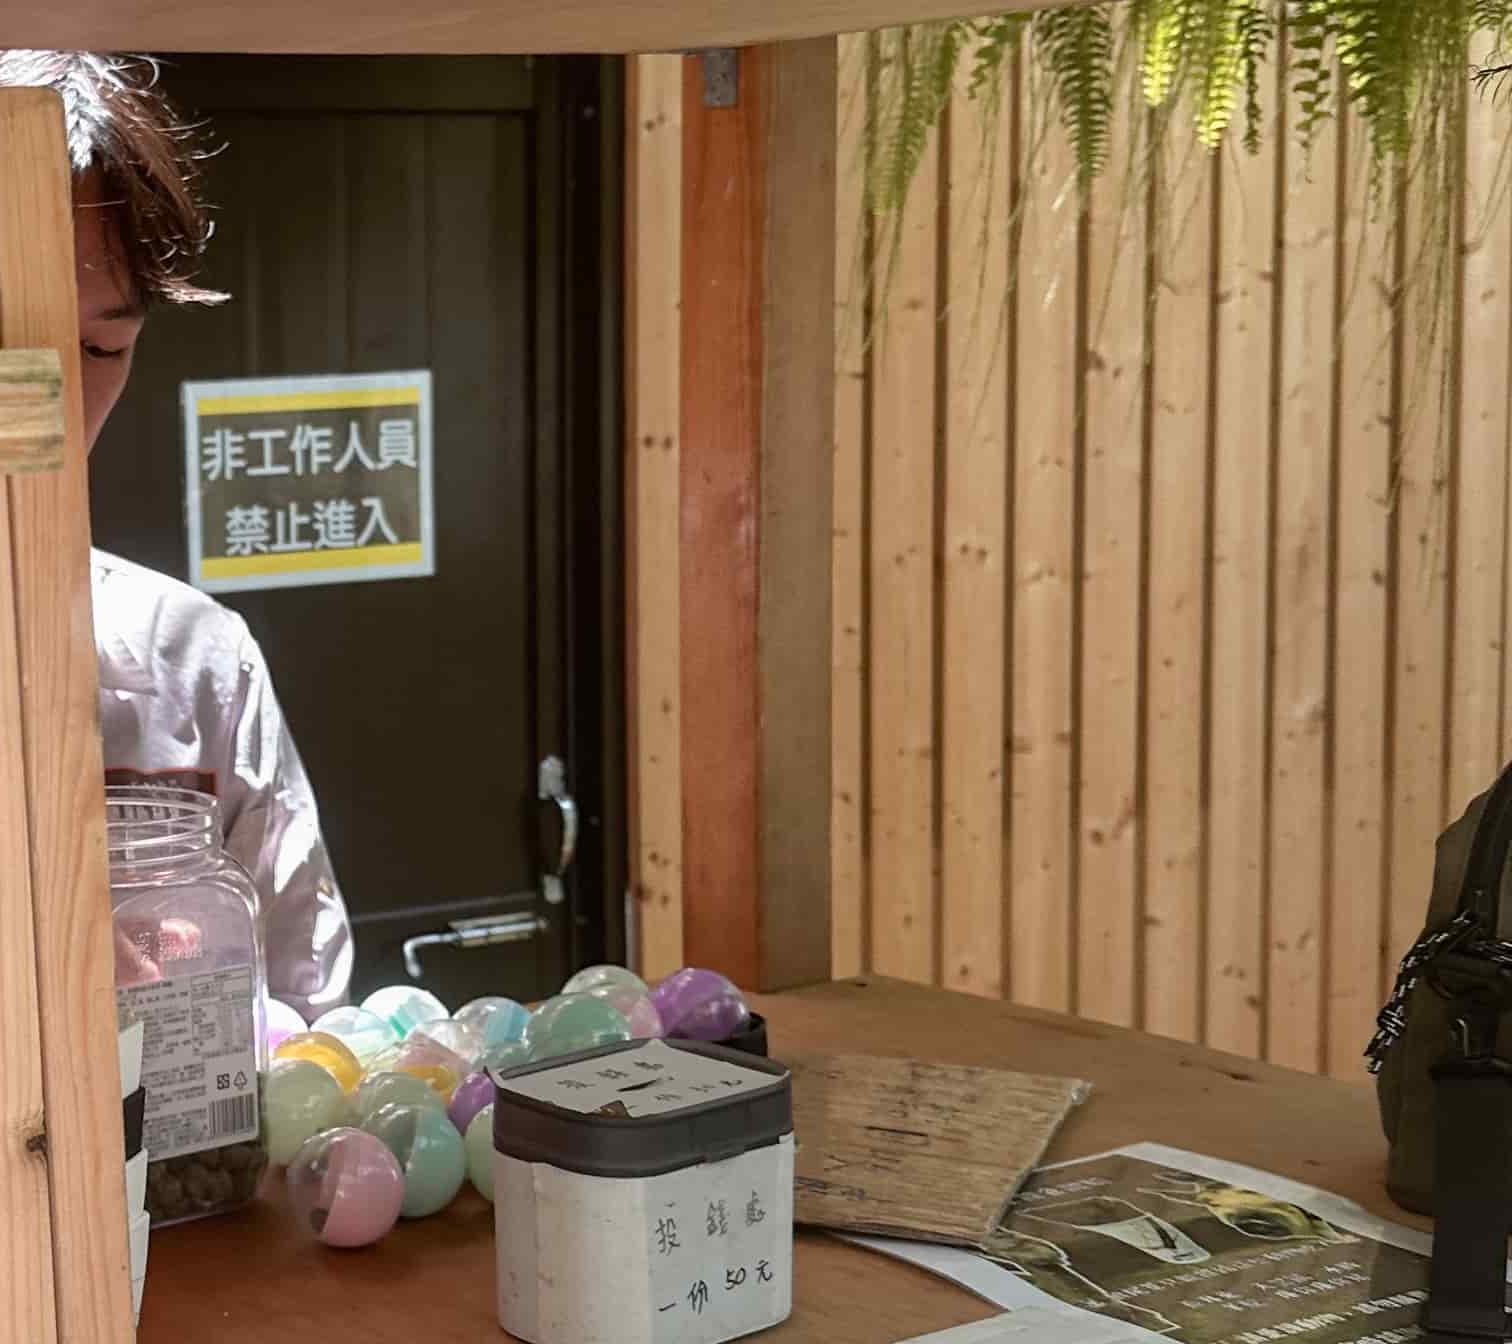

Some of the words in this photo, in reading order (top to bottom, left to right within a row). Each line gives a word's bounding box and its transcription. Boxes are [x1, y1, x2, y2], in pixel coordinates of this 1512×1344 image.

[201, 418, 417, 480] 非工作人員
[225, 497, 399, 556] 禁止進入
